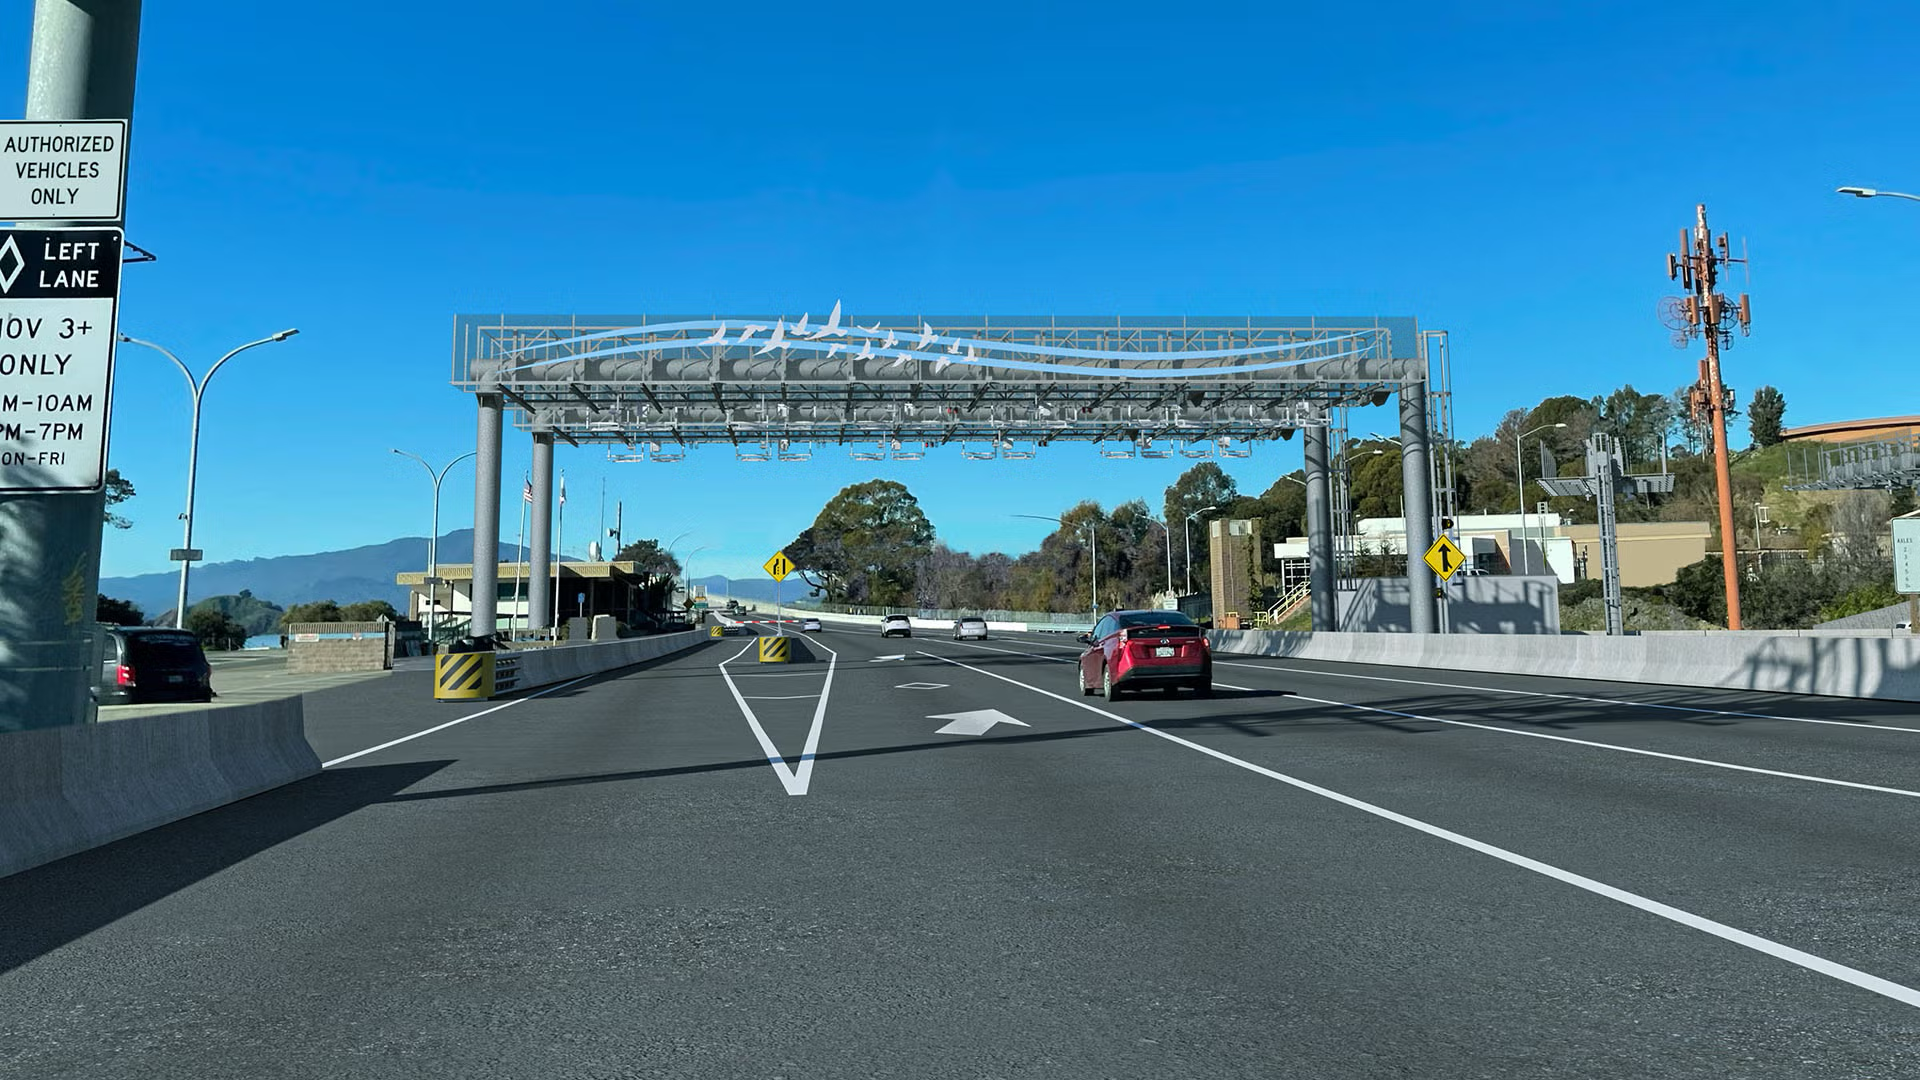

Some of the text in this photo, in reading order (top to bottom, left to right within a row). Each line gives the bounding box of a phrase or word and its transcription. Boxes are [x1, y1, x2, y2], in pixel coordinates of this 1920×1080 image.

[4, 136, 115, 152] AUTHORIZED
[16, 162, 100, 178] VEHICLES
[31, 188, 79, 204] ONLY
[44, 242, 100, 260] LEFT
[39, 270, 99, 288] LANE
[0, 317, 92, 339] OV 3+
[0, 354, 72, 375] ONLY
